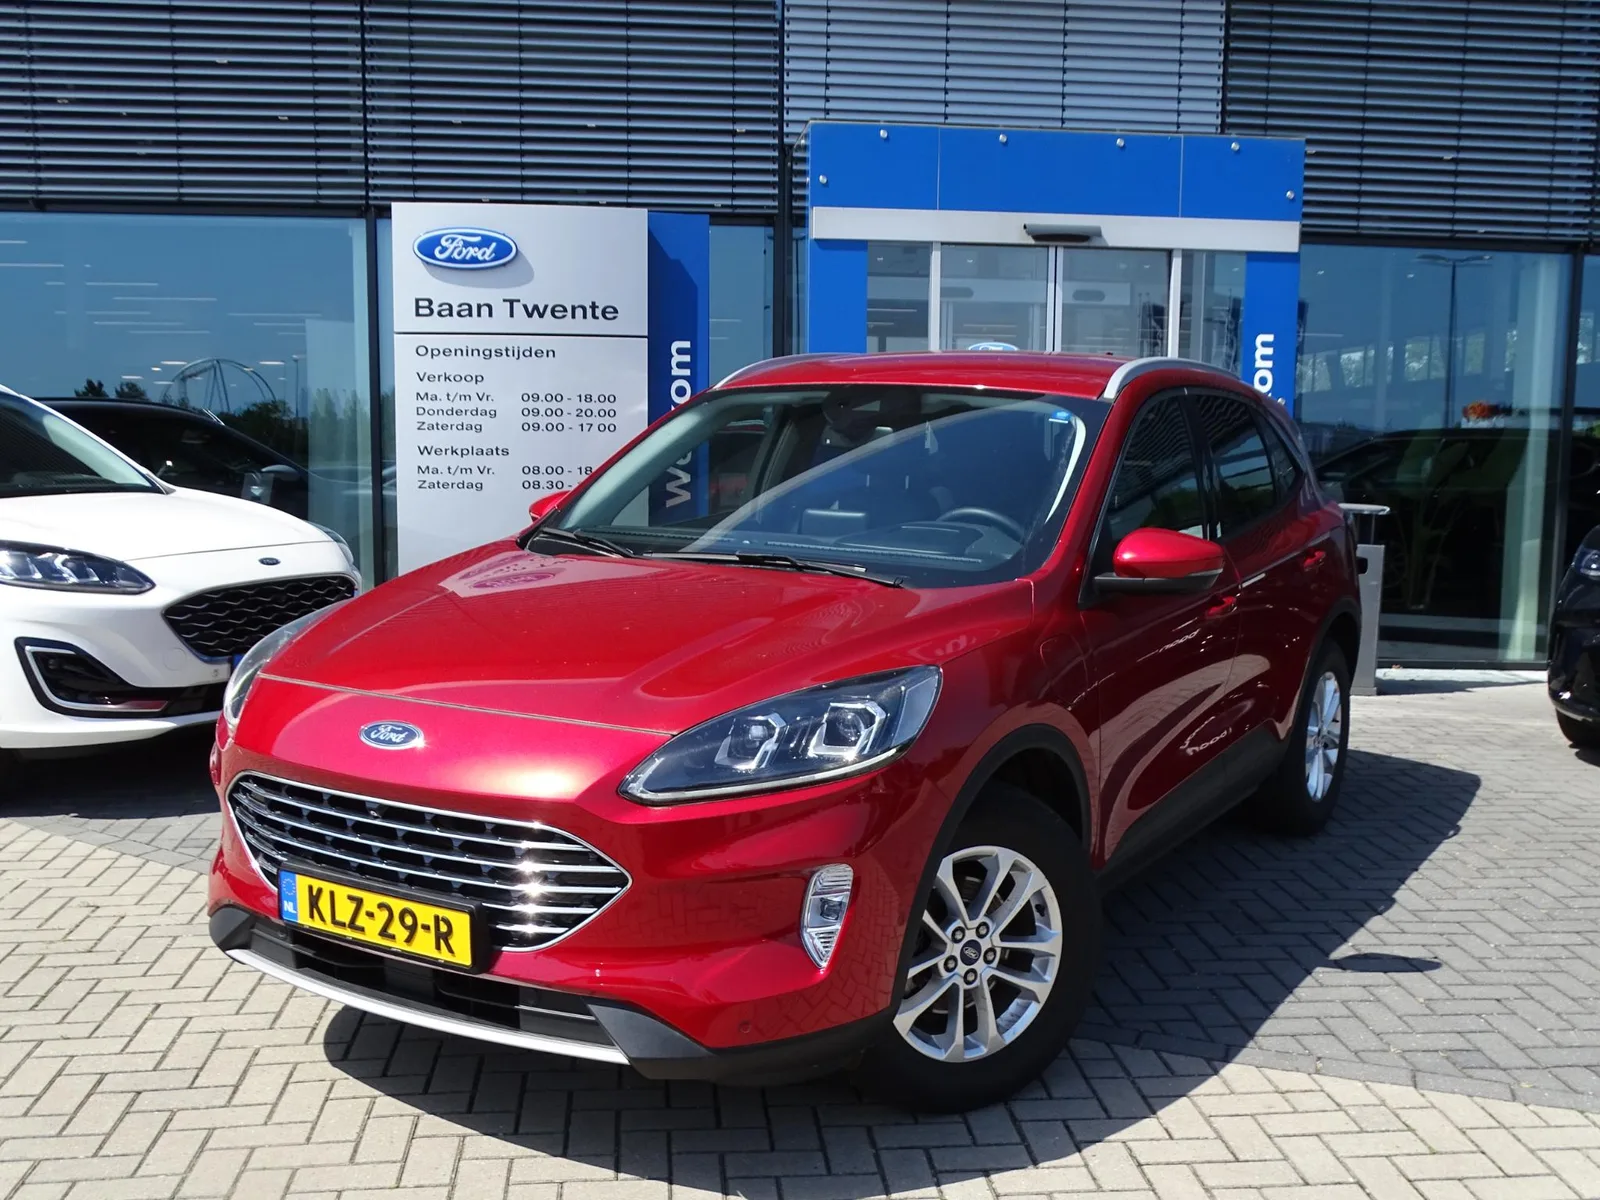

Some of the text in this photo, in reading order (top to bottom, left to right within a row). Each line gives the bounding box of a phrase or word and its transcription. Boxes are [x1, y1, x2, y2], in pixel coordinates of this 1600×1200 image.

[434, 233, 497, 262] Ford
[414, 297, 619, 321] Baan Twente
[415, 344, 556, 360] Openingstijden
[416, 371, 484, 385] Verkoop
[416, 392, 494, 403] Ma. t/m Vr.
[521, 393, 563, 403] 09.00
[577, 393, 617, 404] 18.00
[416, 406, 497, 418] Donderdag
[521, 407, 563, 418] 09.00
[575, 408, 617, 418] 20.00
[416, 421, 483, 433] Zaterdag
[521, 422, 565, 432] 09.00
[417, 445, 510, 457] Werkplaats
[417, 465, 495, 476] Ma. t/m Vr.
[521, 465, 564, 476] 08.00
[577, 466, 593, 475] 18
[417, 480, 484, 491] Zaterdag
[522, 480, 564, 490] 08.30
[370, 724, 409, 744] Ford
[283, 899, 297, 914] NL
[307, 884, 456, 955] KLZ-29-R
